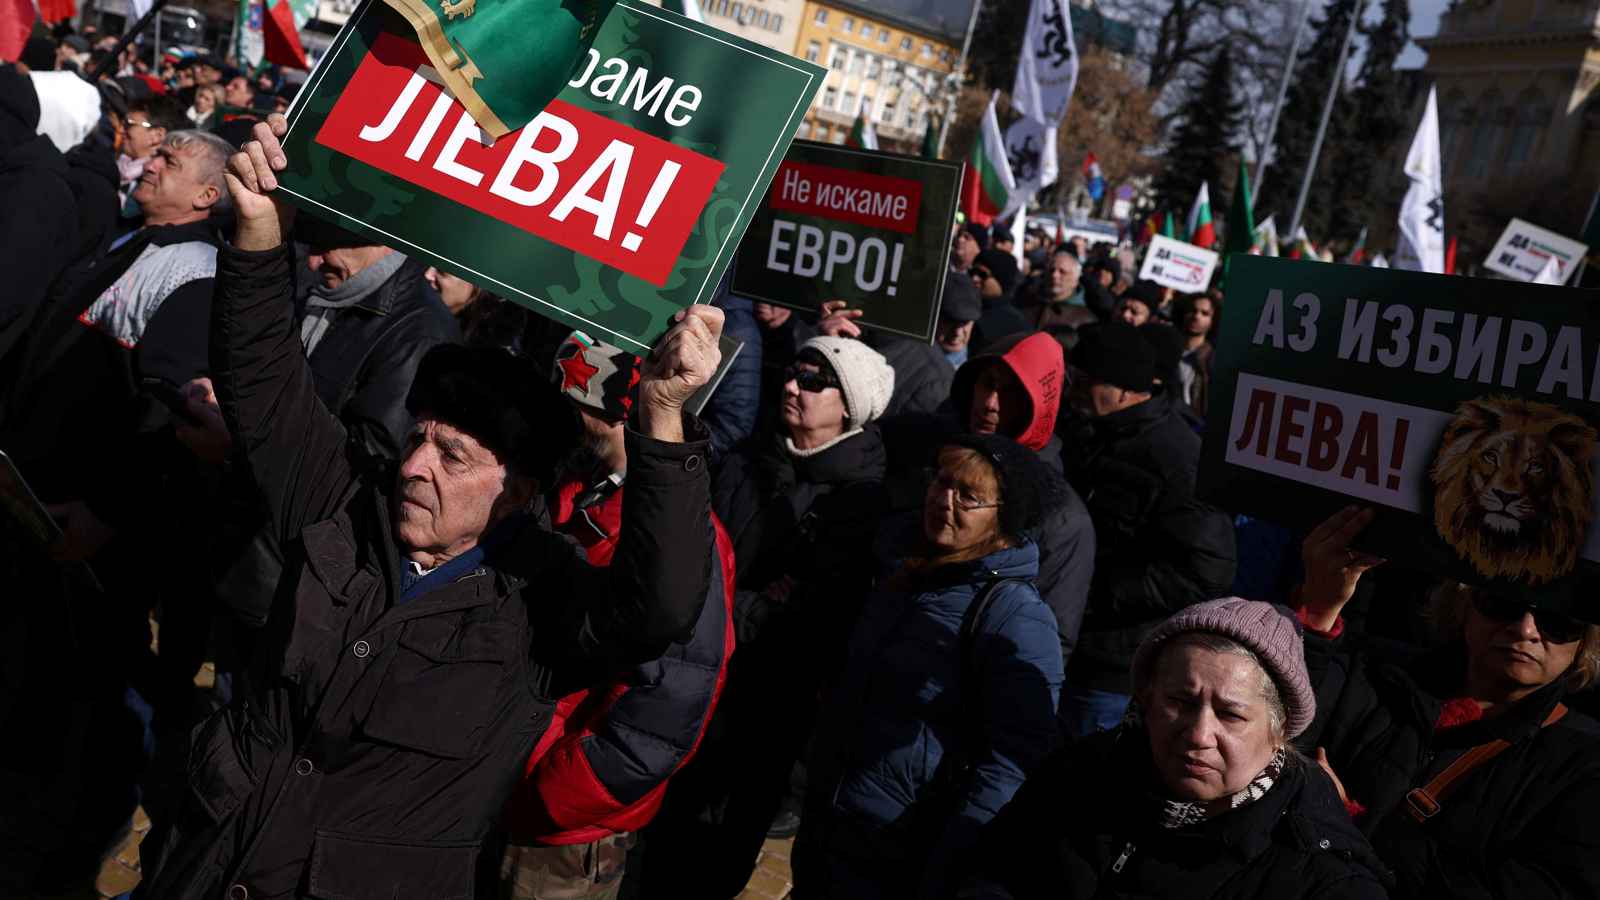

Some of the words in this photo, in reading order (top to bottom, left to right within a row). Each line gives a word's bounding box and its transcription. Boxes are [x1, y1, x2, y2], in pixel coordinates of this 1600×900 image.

[359, 64, 682, 253] ЛЕВА!
[782, 168, 811, 204] Не
[816, 182, 908, 220] искаме
[767, 219, 904, 296] ЕВРО!
[1252, 288, 1321, 352] АЗ
[1337, 298, 1600, 402] ИЗБИРА
[1235, 388, 1410, 491] ЛЕВА!
